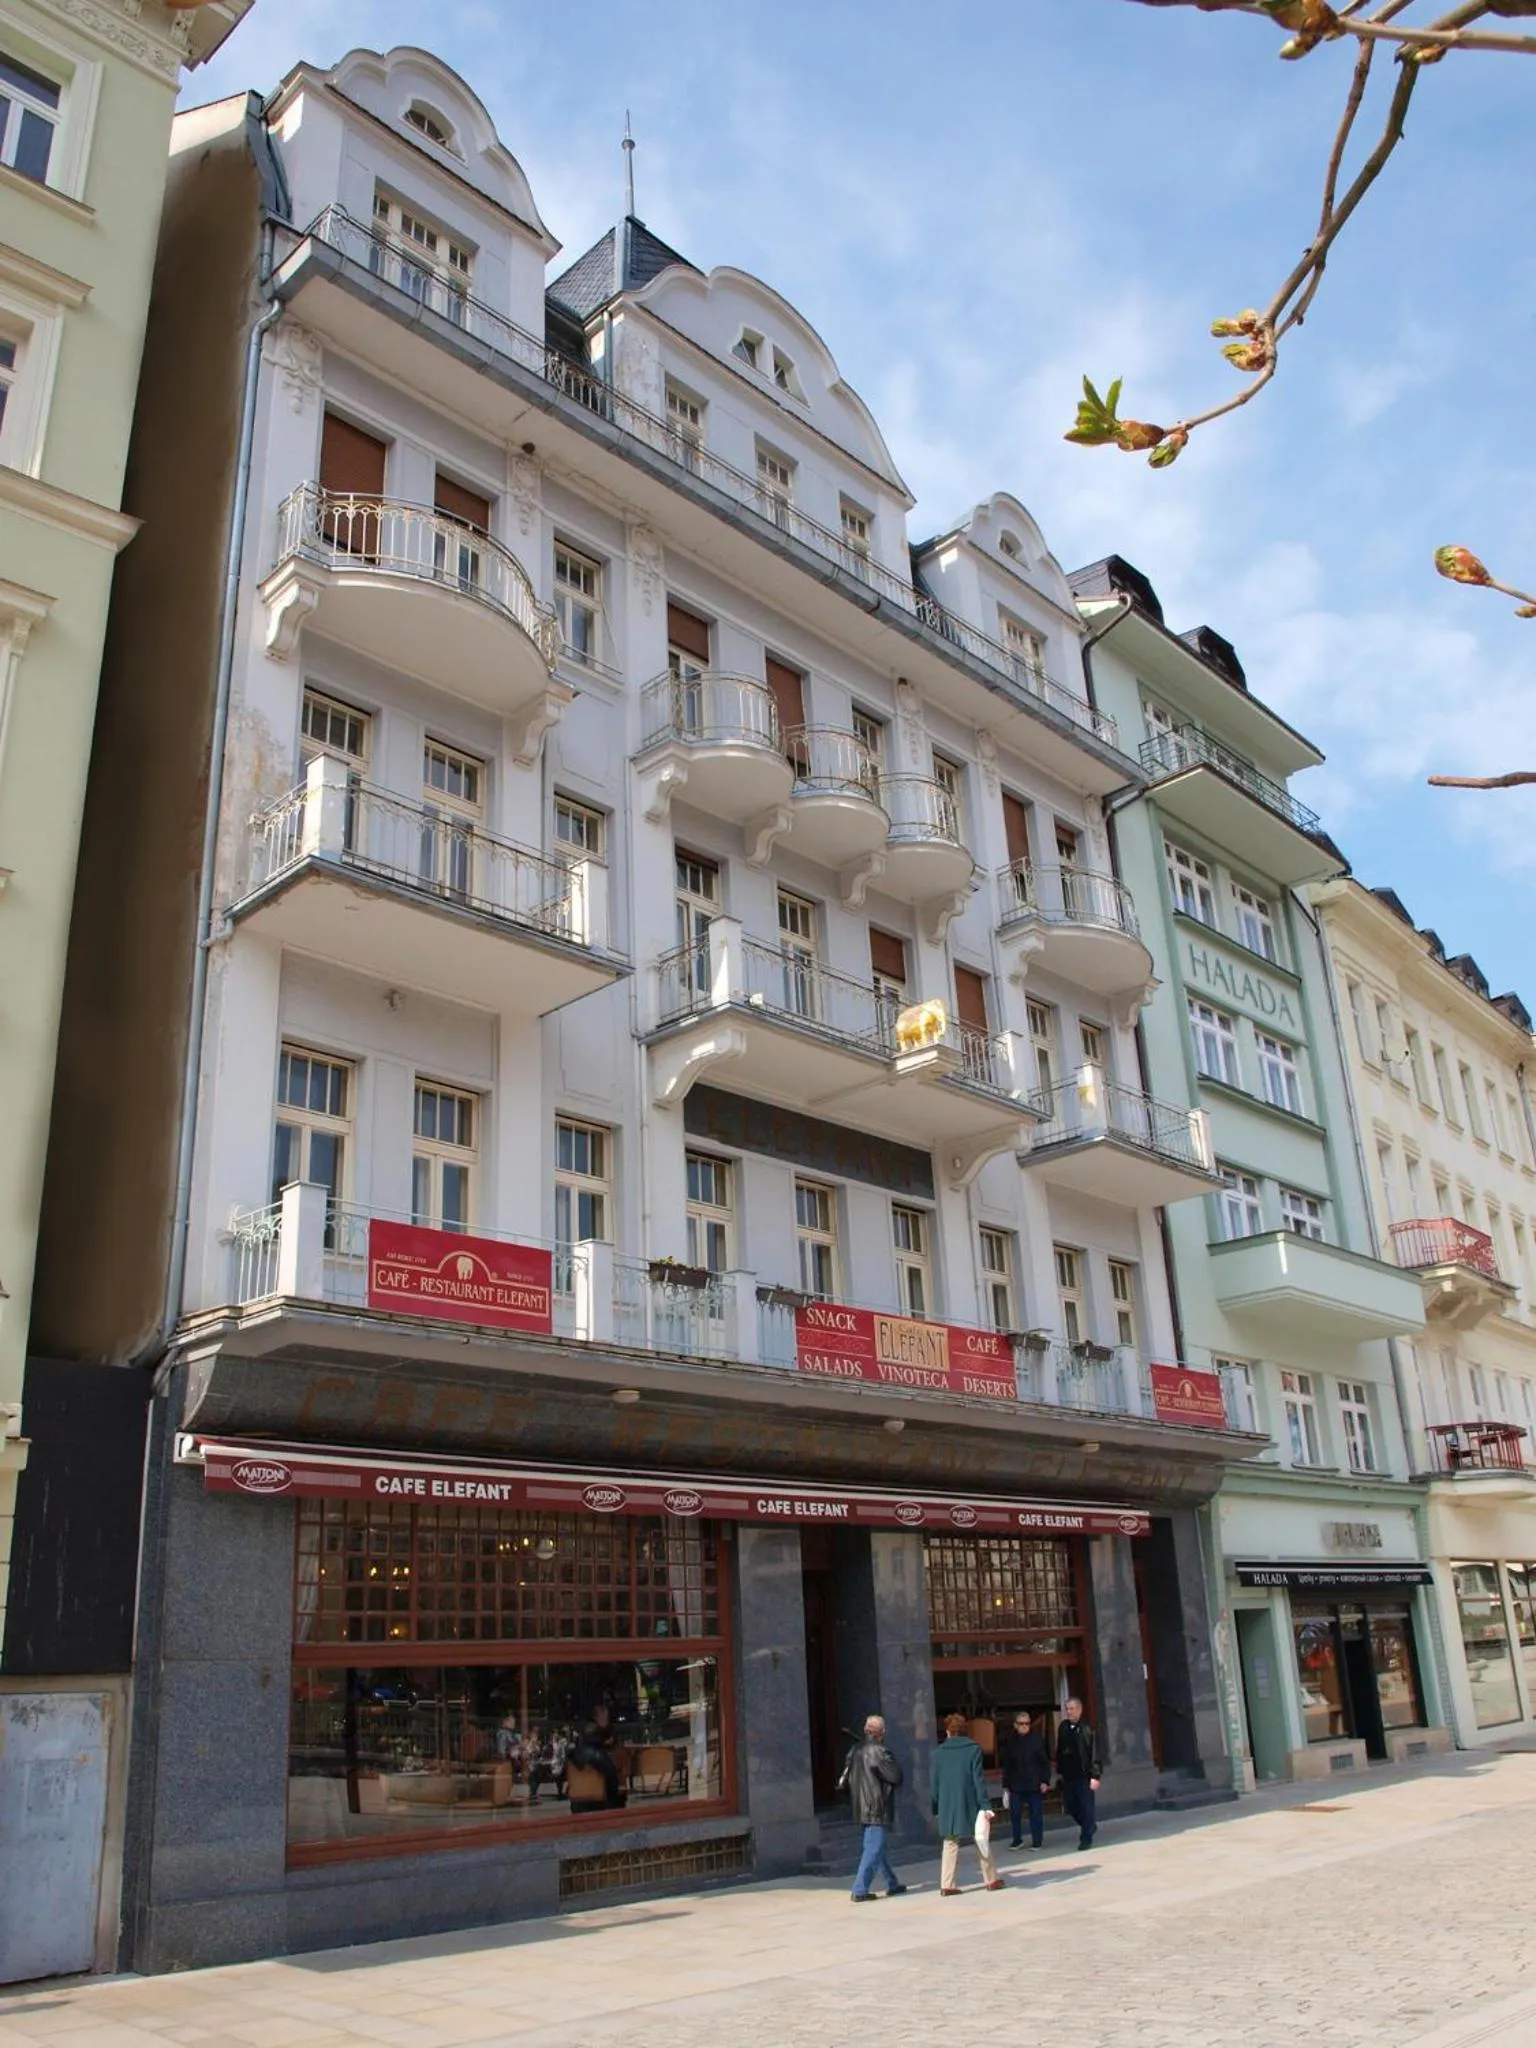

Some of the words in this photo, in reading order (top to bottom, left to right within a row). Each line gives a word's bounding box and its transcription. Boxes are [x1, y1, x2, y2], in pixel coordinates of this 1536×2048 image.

[1188, 943, 1296, 1028] HALADA
[377, 1269, 410, 1289] CAFÉ
[420, 1277, 495, 1302] RESTAURANT
[497, 1288, 544, 1310] ELEFANT
[806, 1307, 857, 1331] SNACK
[880, 1320, 945, 1368] ELEFANT
[966, 1335, 1000, 1355] CAFÉ
[804, 1354, 863, 1377] SALADS
[877, 1363, 950, 1389] VINOTECA
[963, 1376, 1016, 1399] DESERTS
[375, 1475, 426, 1495] CAFE
[431, 1479, 513, 1500] ELEFANT
[757, 1499, 791, 1515] CAFE
[795, 1501, 849, 1517] ELEFANT
[1018, 1514, 1043, 1526] CAFE
[1045, 1515, 1084, 1528] ELEFANT
[1254, 1573, 1289, 1585] HALADA
